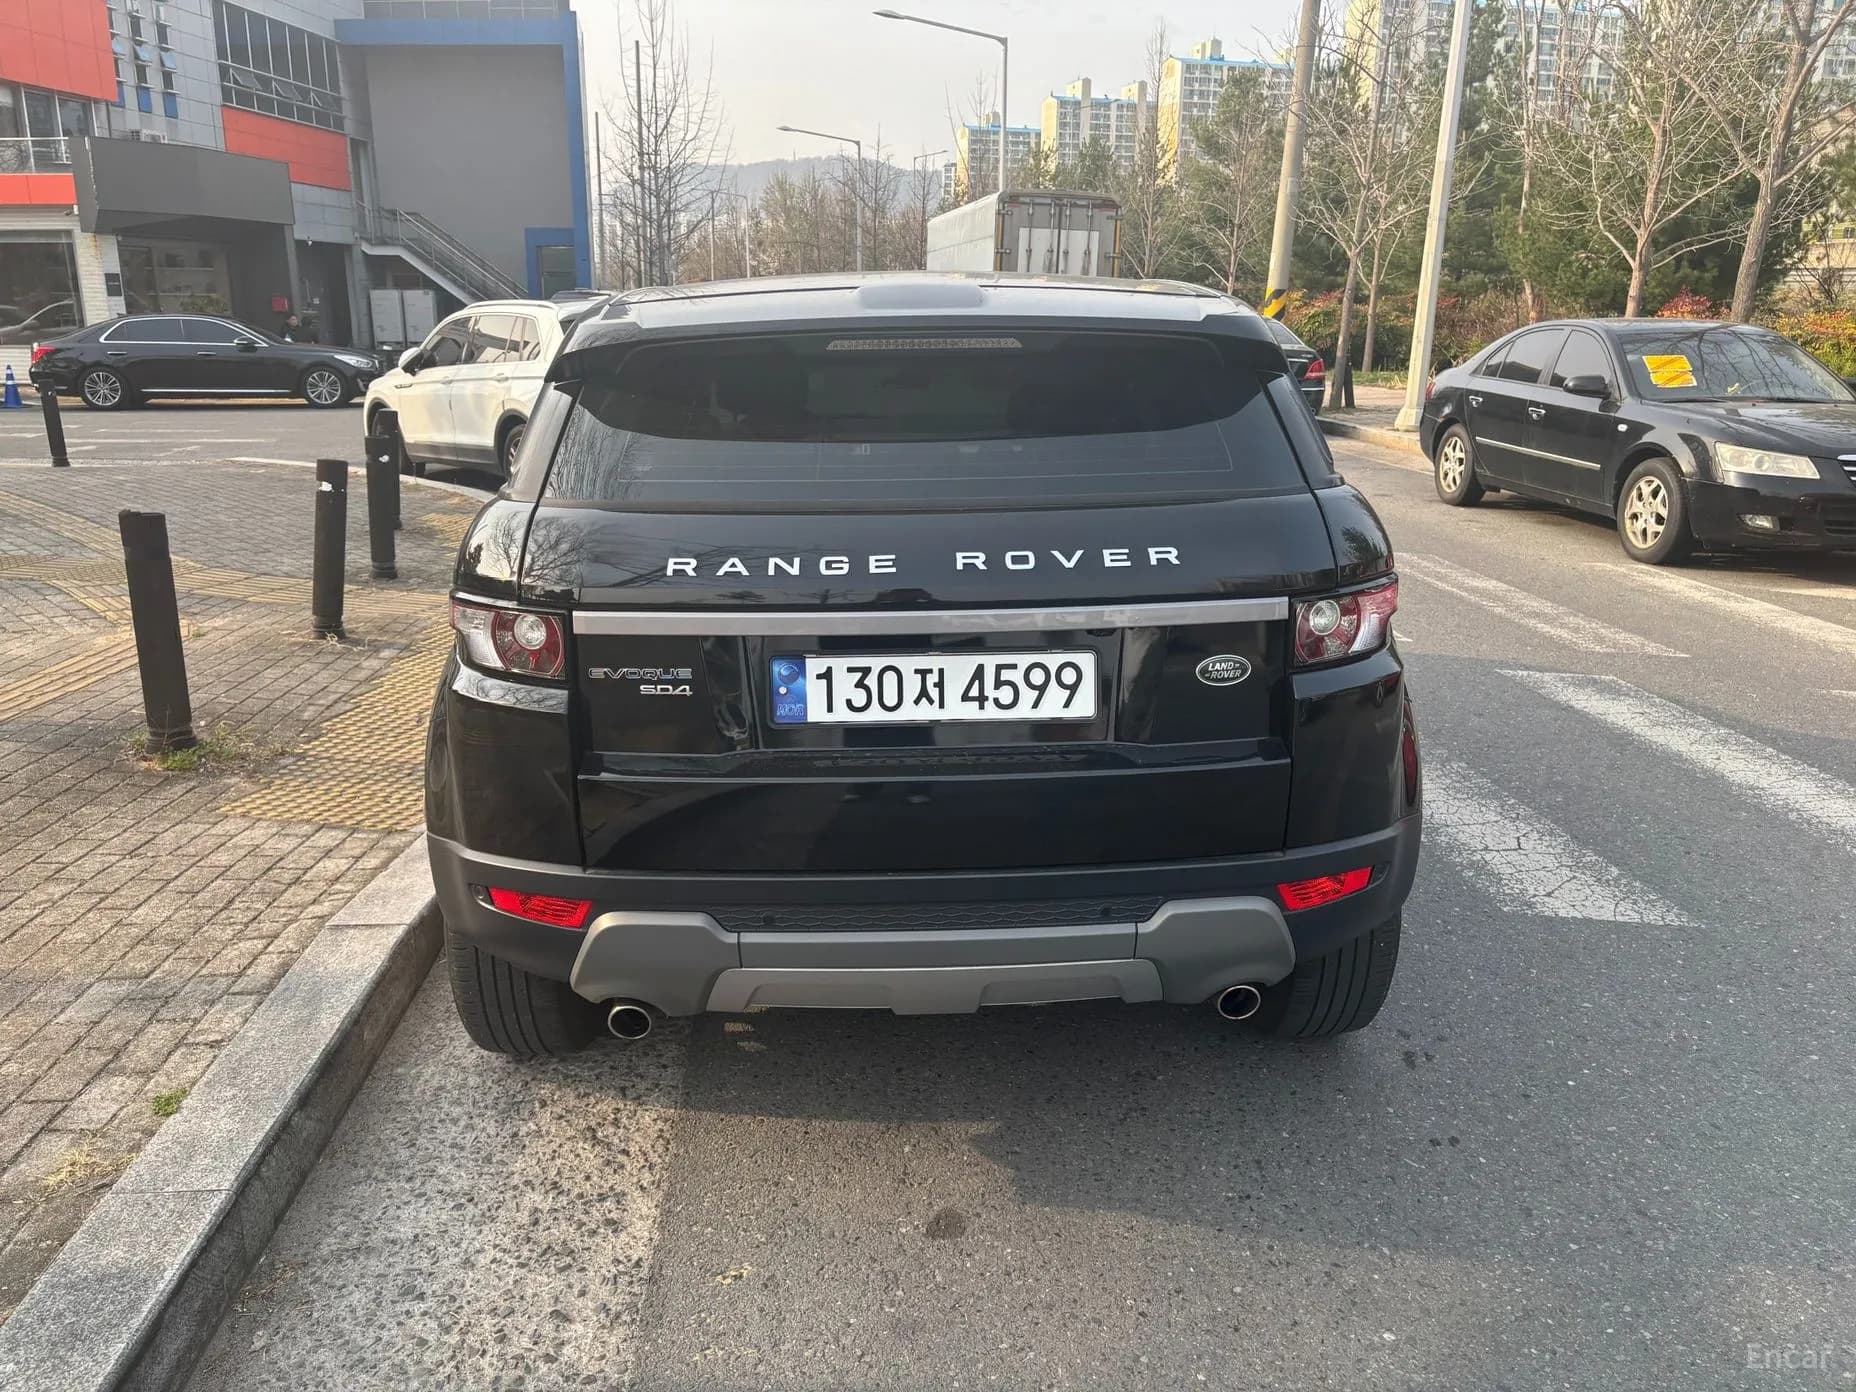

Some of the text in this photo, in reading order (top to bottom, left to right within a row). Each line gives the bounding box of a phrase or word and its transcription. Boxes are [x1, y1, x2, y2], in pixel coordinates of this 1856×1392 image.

[666, 547, 1181, 577] RANGE ROVER
[1207, 661, 1235, 671] LAND
[588, 667, 693, 681] EVOQUE
[1210, 669, 1242, 679] ROVER
[639, 684, 693, 697] SD4
[815, 661, 1084, 714] 130저 4599
